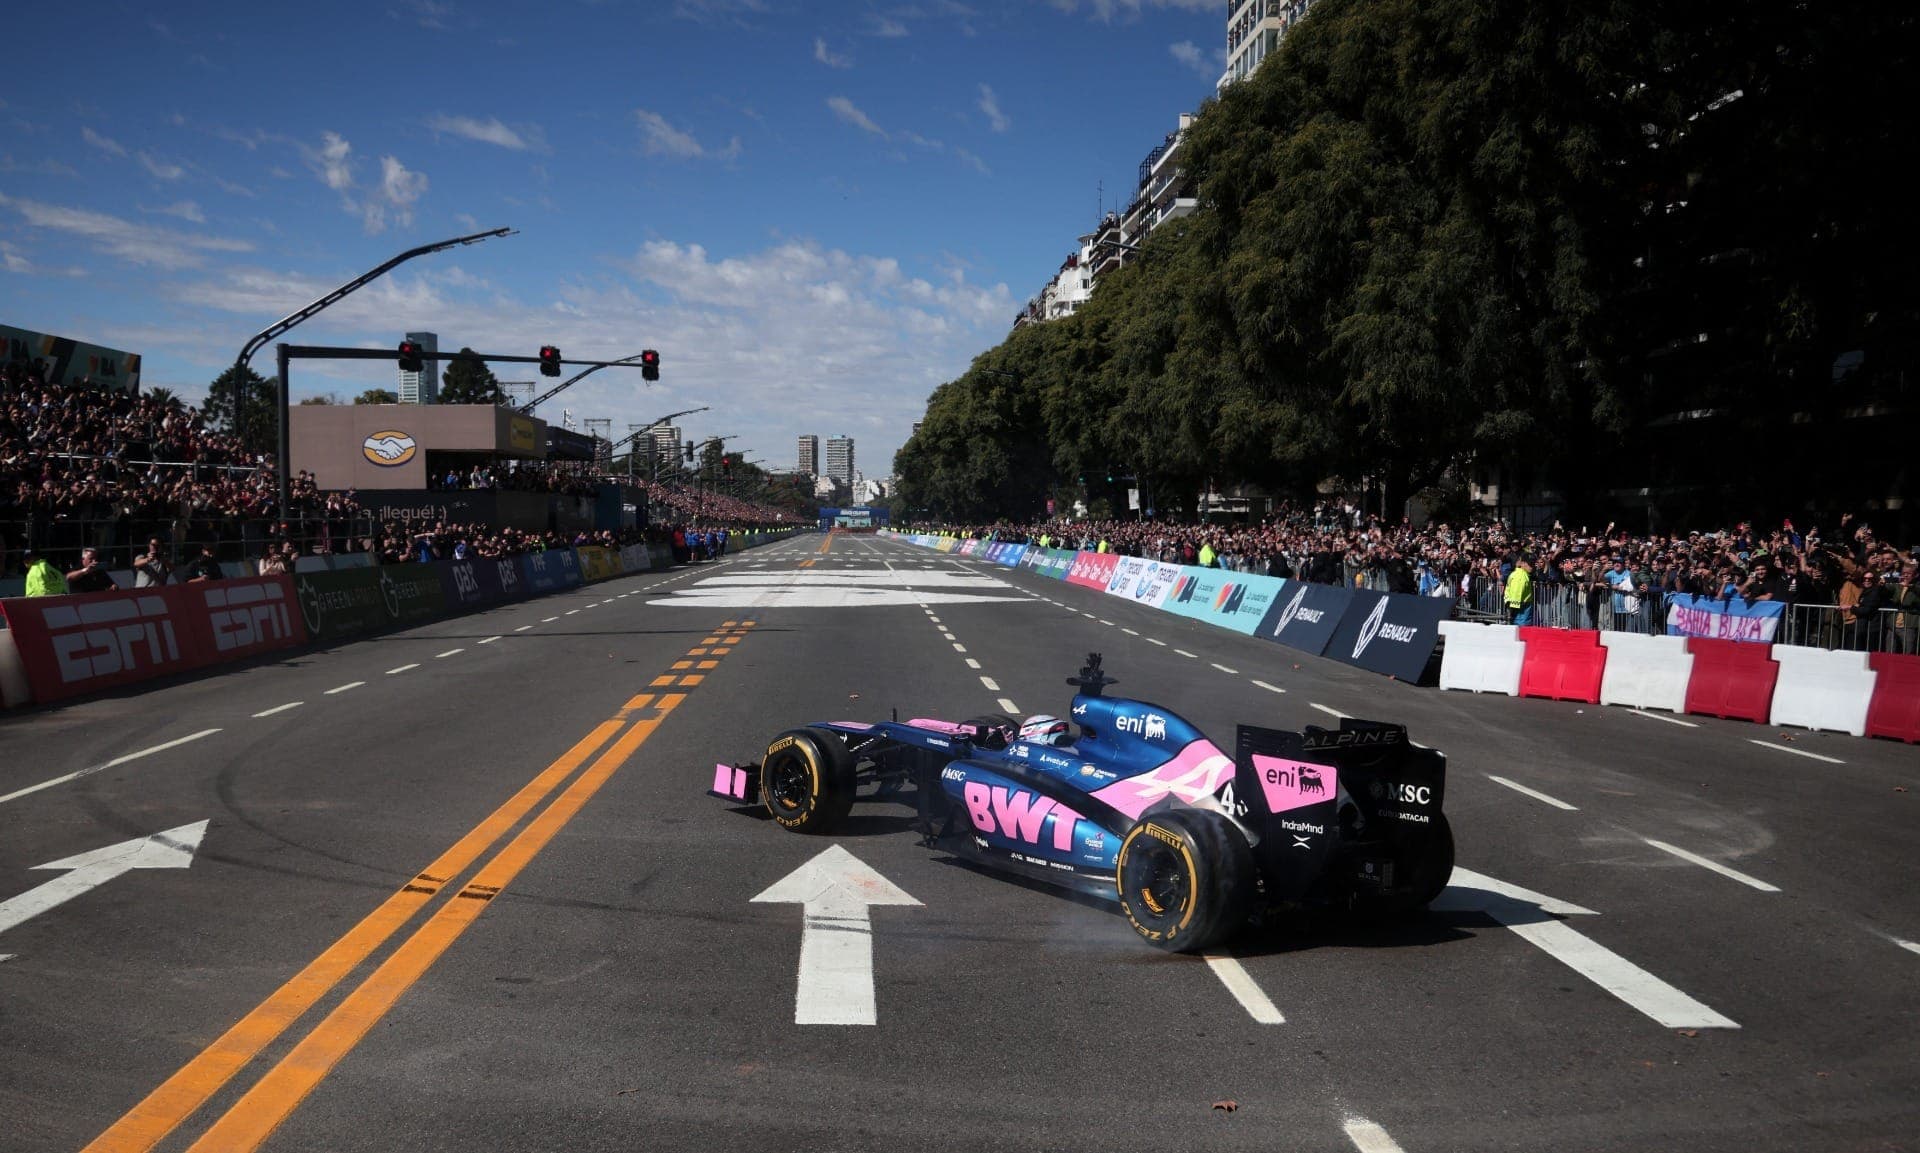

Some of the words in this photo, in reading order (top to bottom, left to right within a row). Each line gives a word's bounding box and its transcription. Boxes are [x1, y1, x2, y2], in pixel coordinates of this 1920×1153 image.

[452, 562, 479, 600] pax
[497, 560, 518, 592] pax
[204, 582, 292, 651] ESPN
[1295, 607, 1325, 624] RENAULT
[41, 595, 180, 683] ESPN
[1378, 622, 1418, 643] RENAULT
[1116, 714, 1145, 734] eni
[768, 735, 793, 755] PIRELLI
[1304, 730, 1398, 747] ALPINE
[946, 768, 966, 781] MSC
[1266, 766, 1296, 788] eni
[1386, 782, 1430, 805] MSC
[776, 812, 808, 827] ZERO
[964, 781, 1087, 851] BWT
[1145, 822, 1183, 850] PIRELLI
[1121, 901, 1160, 940] ZERO
